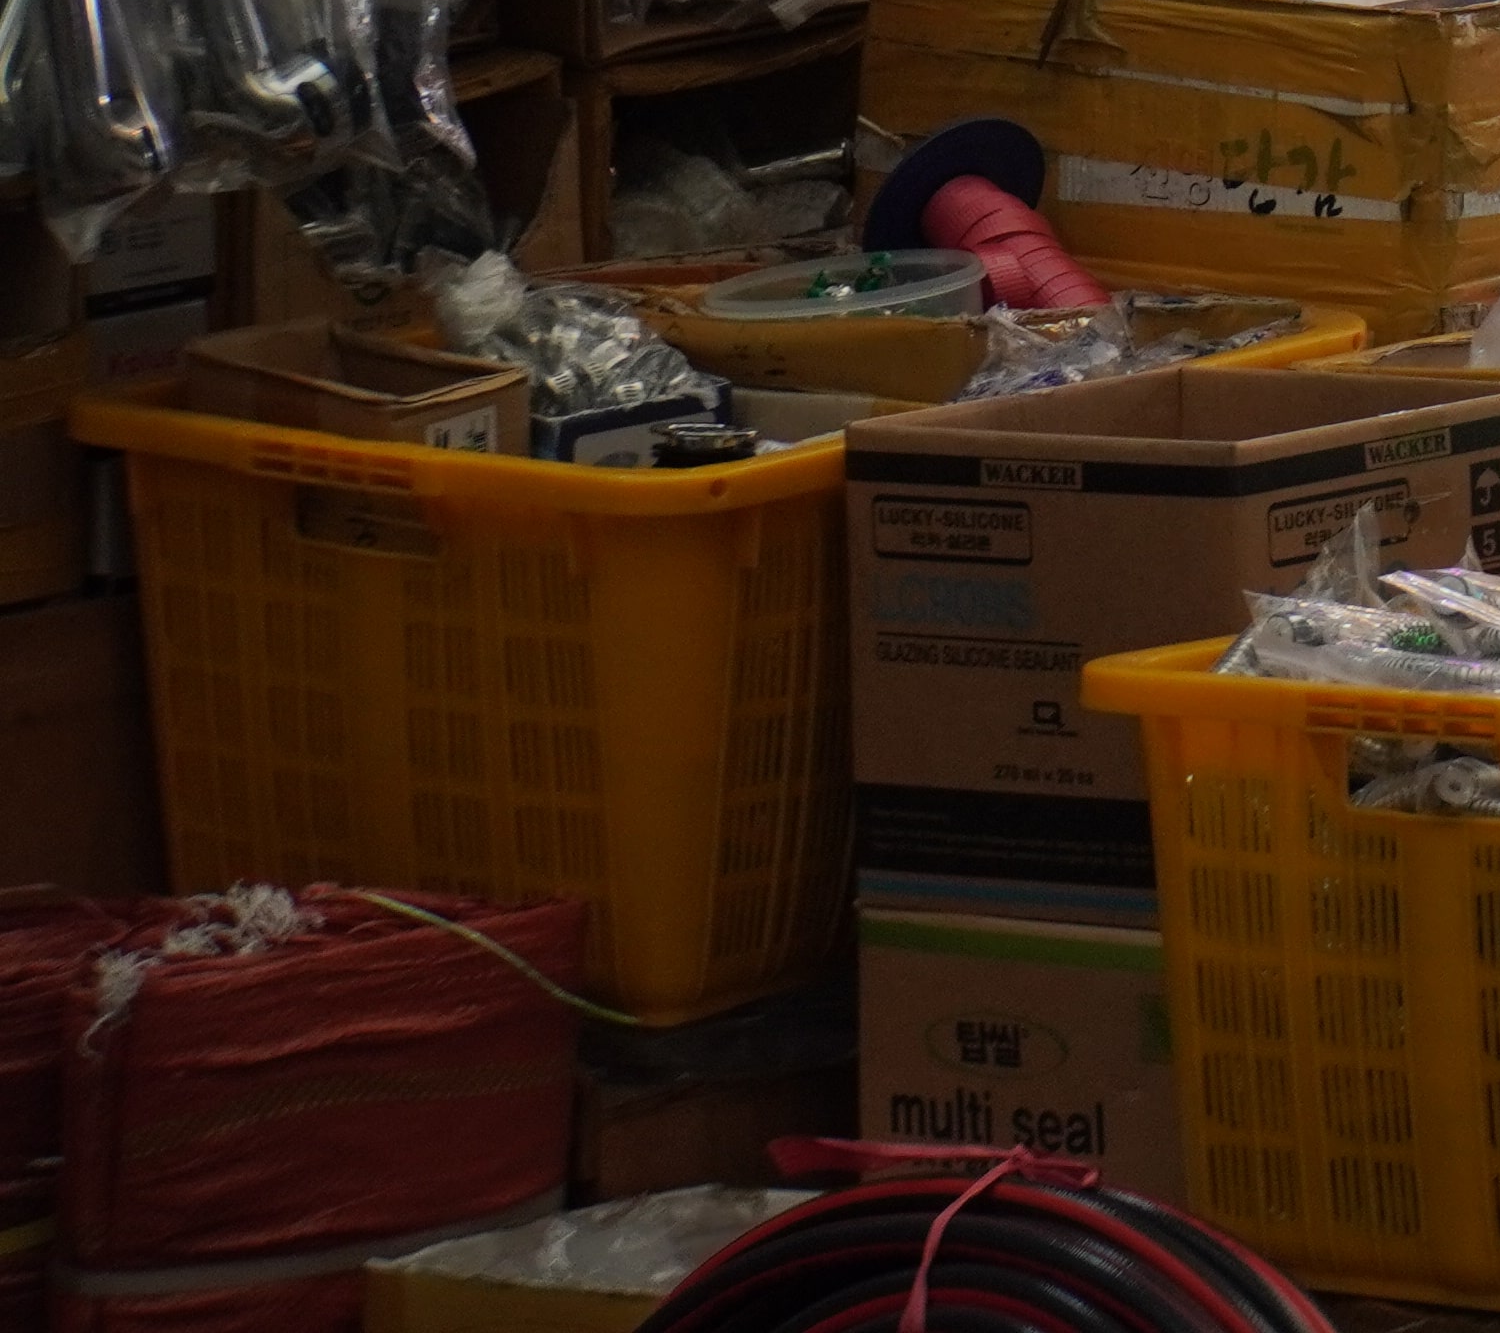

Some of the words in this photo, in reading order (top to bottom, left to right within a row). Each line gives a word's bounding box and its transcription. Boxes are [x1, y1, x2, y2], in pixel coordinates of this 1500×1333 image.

[1367, 434, 1448, 465] WACKER
[984, 461, 1077, 485] WACKER
[877, 506, 1025, 532] LUCKY-SILICONE
[890, 1086, 993, 1144] multi
[1011, 1101, 1107, 1156] seal
